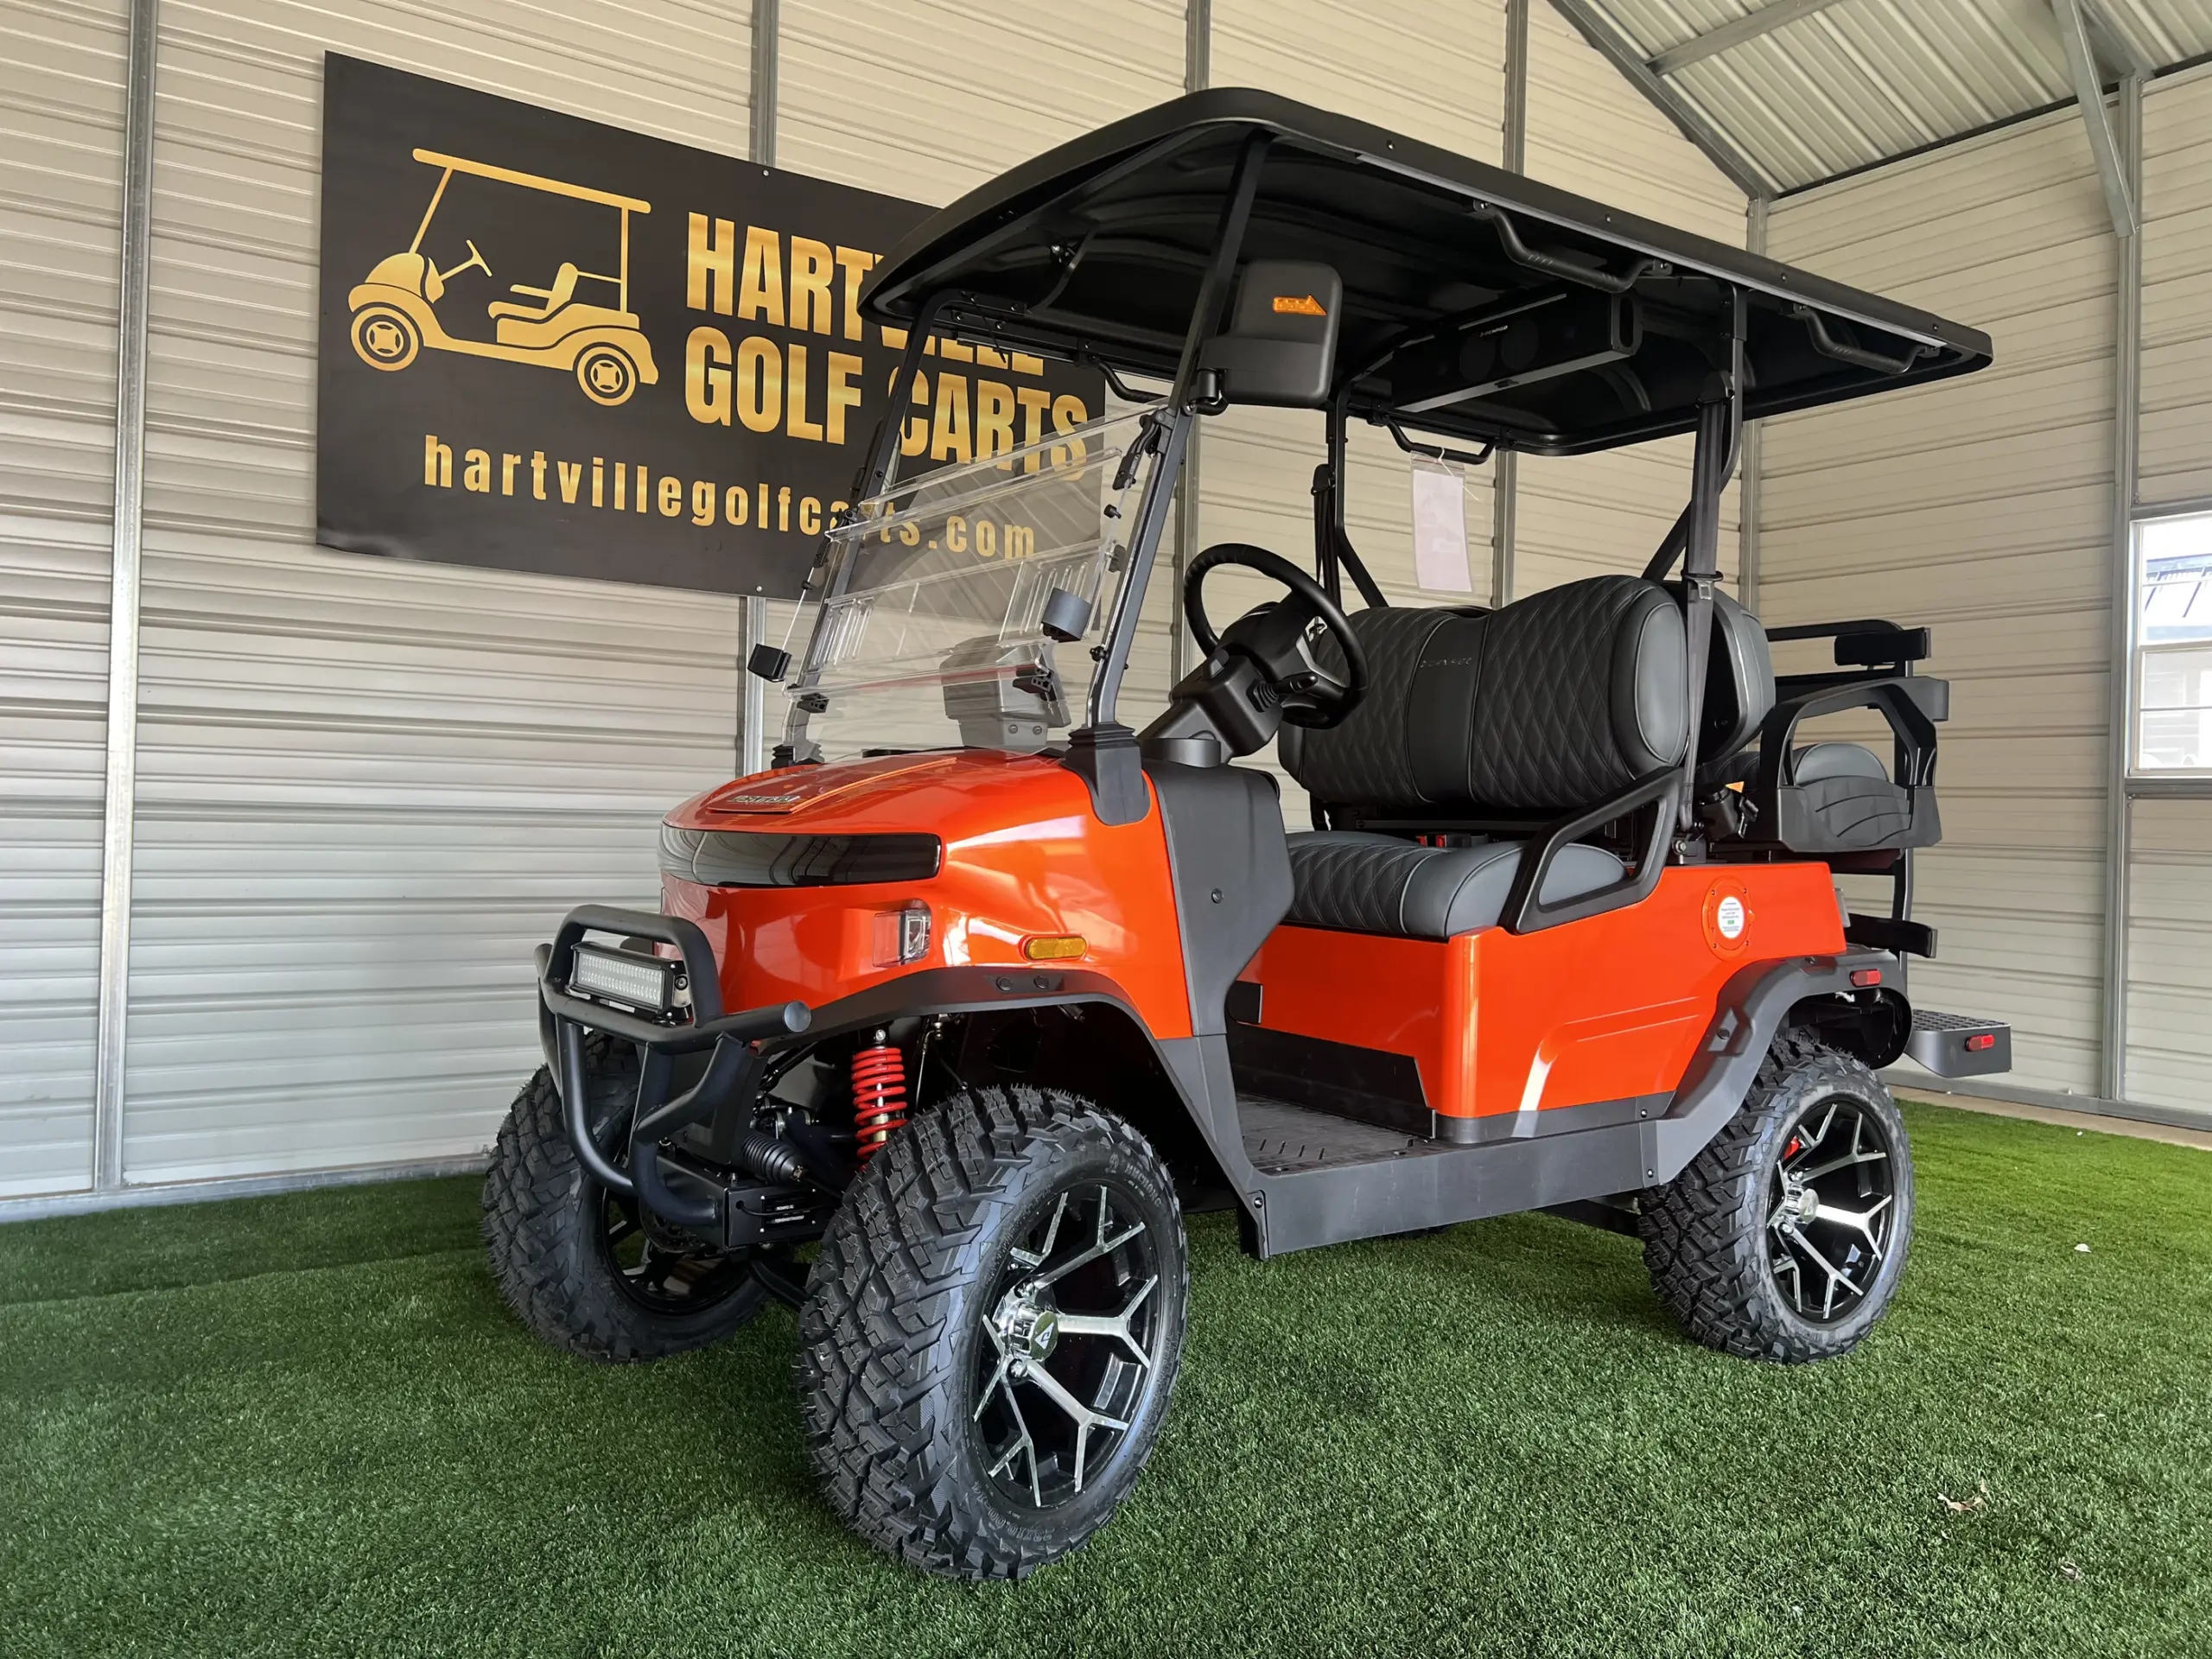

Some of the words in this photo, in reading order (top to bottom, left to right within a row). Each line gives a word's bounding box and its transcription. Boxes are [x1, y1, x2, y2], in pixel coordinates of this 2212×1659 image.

[685, 326, 862, 445] GOLF
[888, 365, 1088, 481] CARTS
[424, 434, 1034, 560] hartvillegolfcts.com
